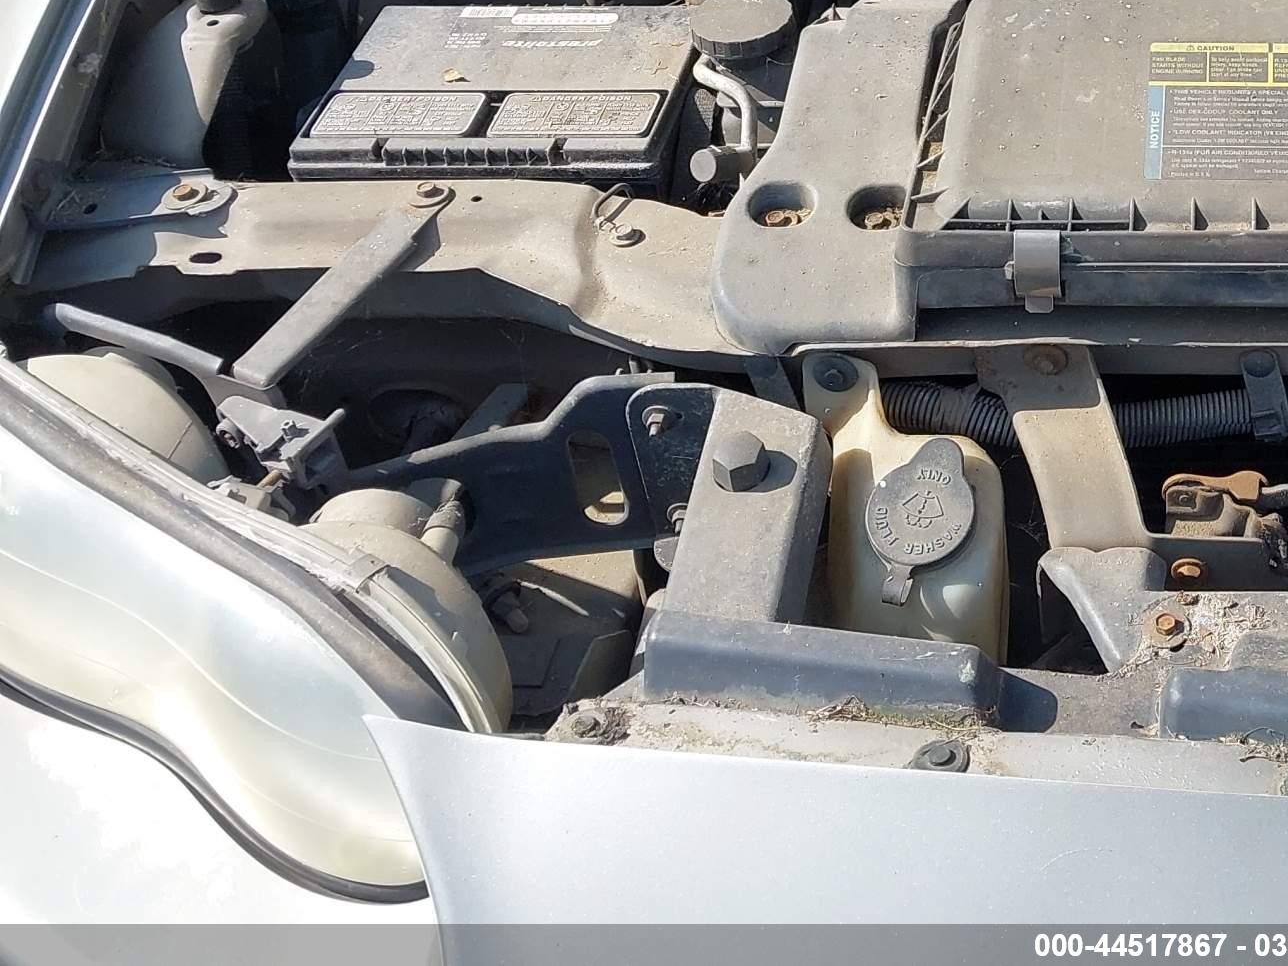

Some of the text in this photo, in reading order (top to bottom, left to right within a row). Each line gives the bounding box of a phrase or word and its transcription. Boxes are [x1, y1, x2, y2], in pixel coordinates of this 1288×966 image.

[502, 38, 604, 48] prestolite
[1150, 110, 1160, 148] NOTICE
[875, 468, 962, 556] WASHER FLUID ONLY
